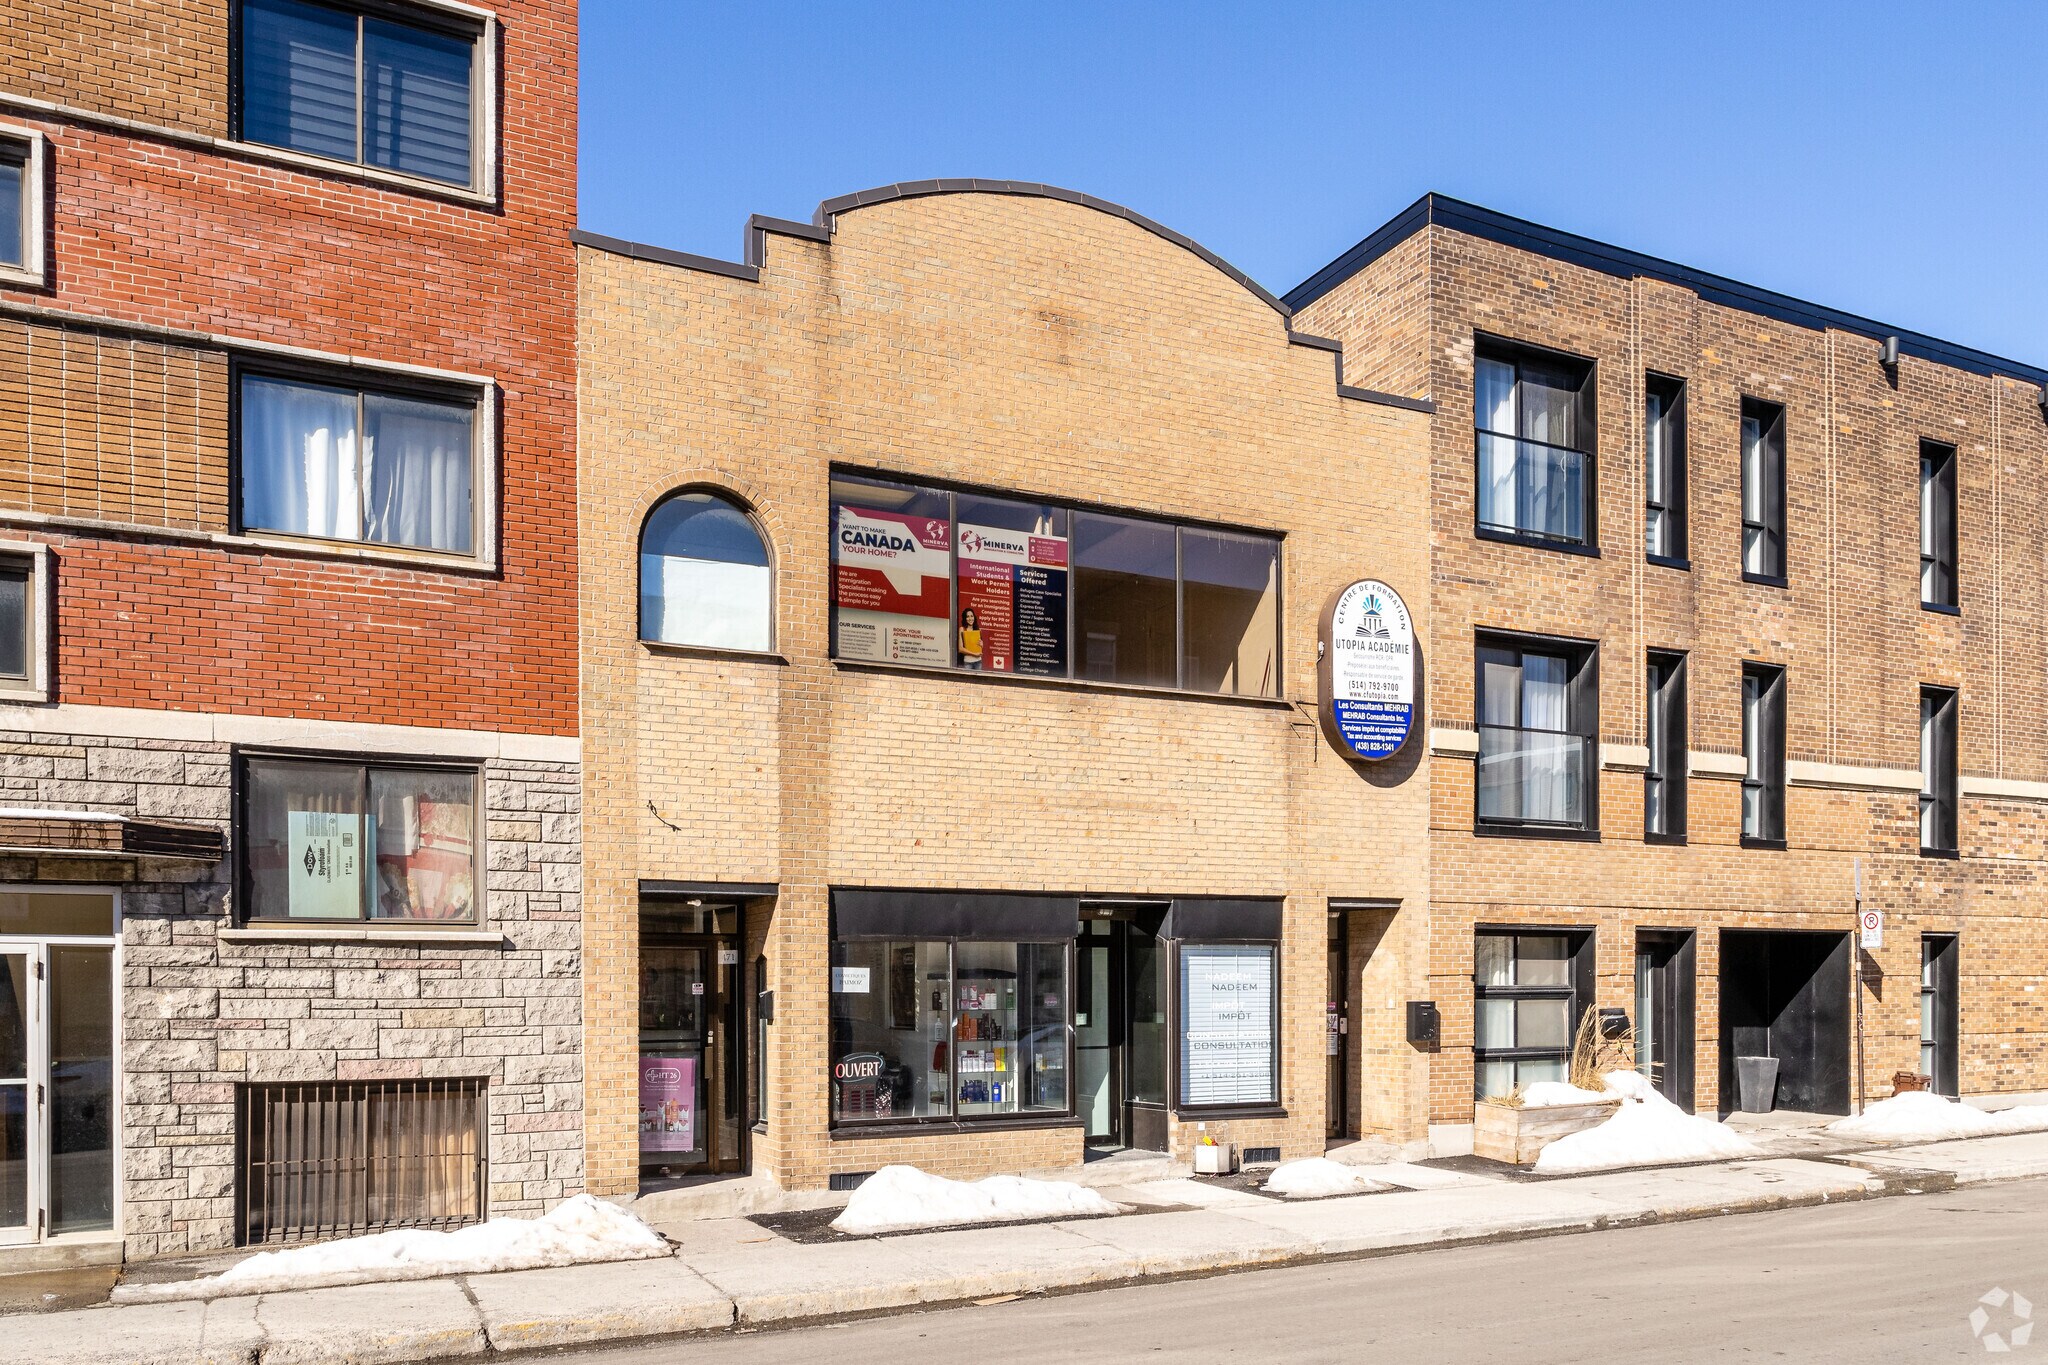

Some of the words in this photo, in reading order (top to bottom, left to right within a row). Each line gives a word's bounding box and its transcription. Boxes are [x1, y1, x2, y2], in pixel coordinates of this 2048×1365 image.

[841, 530, 915, 552] CANADA
[984, 540, 1024, 552] MINERVA
[842, 545, 866, 554] YOUR
[868, 548, 897, 558] HOME?
[970, 564, 1010, 573] International
[1020, 570, 1047, 578] Services
[839, 577, 871, 585] Immigration
[1338, 588, 1357, 624] CENTRE
[1372, 585, 1406, 630] FORMATION
[1336, 639, 1365, 651] UTOPIA
[1368, 640, 1409, 654] ACADÉMIE
[1349, 681, 1366, 690] (514)
[1369, 682, 1399, 691] 792-9700
[1350, 691, 1399, 700] www.cfutopia.com
[1350, 701, 1383, 711] Consultants
[1385, 704, 1409, 712] MEHRAB
[1366, 713, 1395, 721] Consultants
[1218, 1011, 1251, 1020] IMPÔT
[835, 1062, 880, 1078] OUVERT
